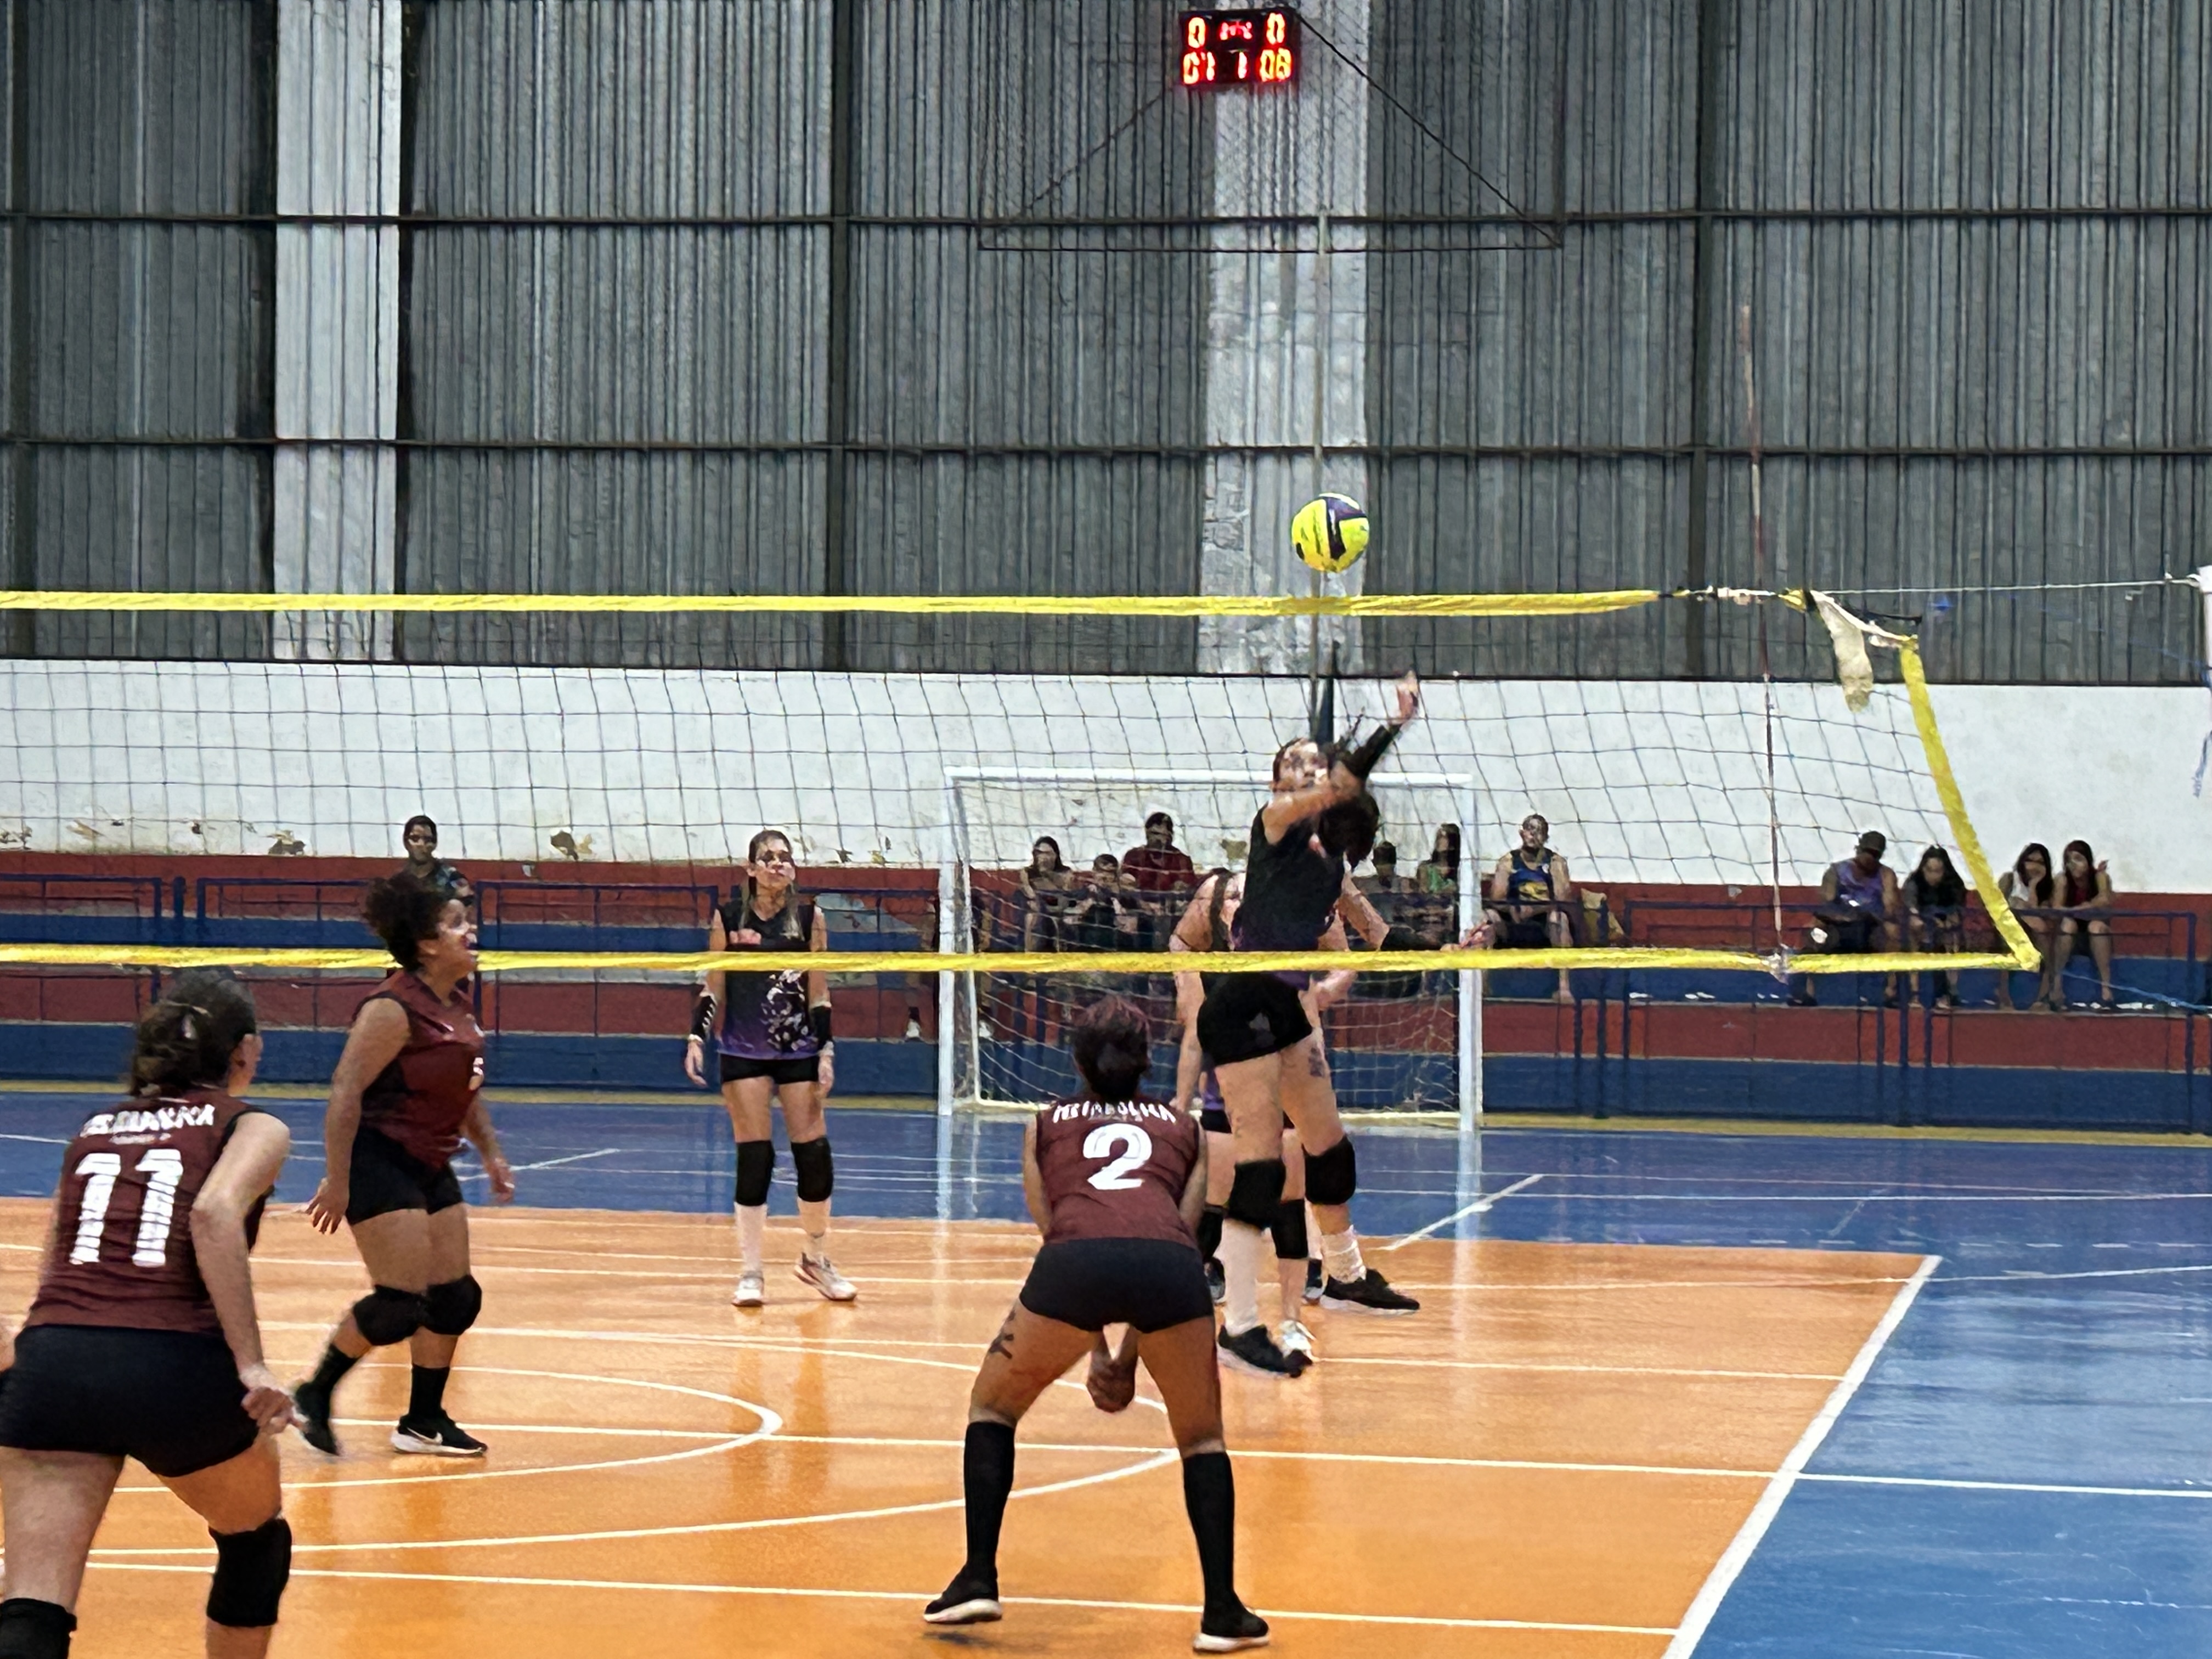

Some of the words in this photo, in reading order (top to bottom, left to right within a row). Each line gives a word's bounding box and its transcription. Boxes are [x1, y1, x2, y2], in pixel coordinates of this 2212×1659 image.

[1188, 16, 1206, 48] 0
[1266, 12, 1285, 45] 0
[1237, 51, 1248, 79] 1
[1083, 1122, 1153, 1190] 2
[69, 1149, 184, 1267] 11
